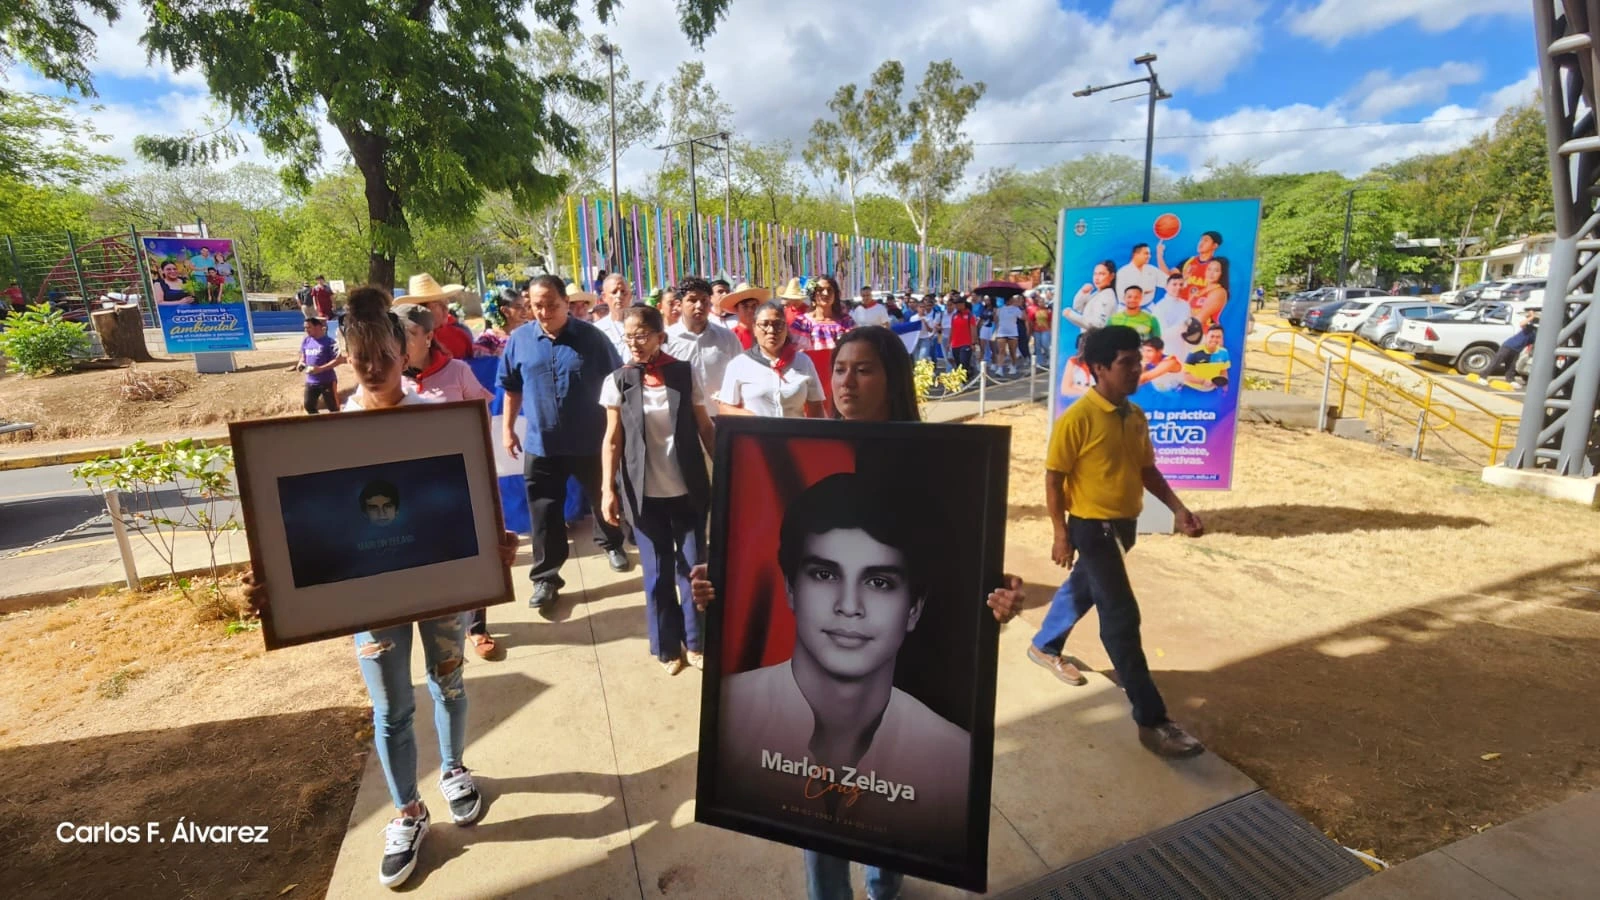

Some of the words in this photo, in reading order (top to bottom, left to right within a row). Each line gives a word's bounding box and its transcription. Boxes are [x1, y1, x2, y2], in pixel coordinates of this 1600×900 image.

[172, 313, 236, 323] conciencia
[170, 319, 243, 334] ambiental
[1154, 410, 1165, 420] la
[1167, 409, 1216, 421] práctica
[1148, 422, 1206, 444] rtiva
[761, 749, 835, 783] Marlon
[840, 765, 915, 802] Zelaya
